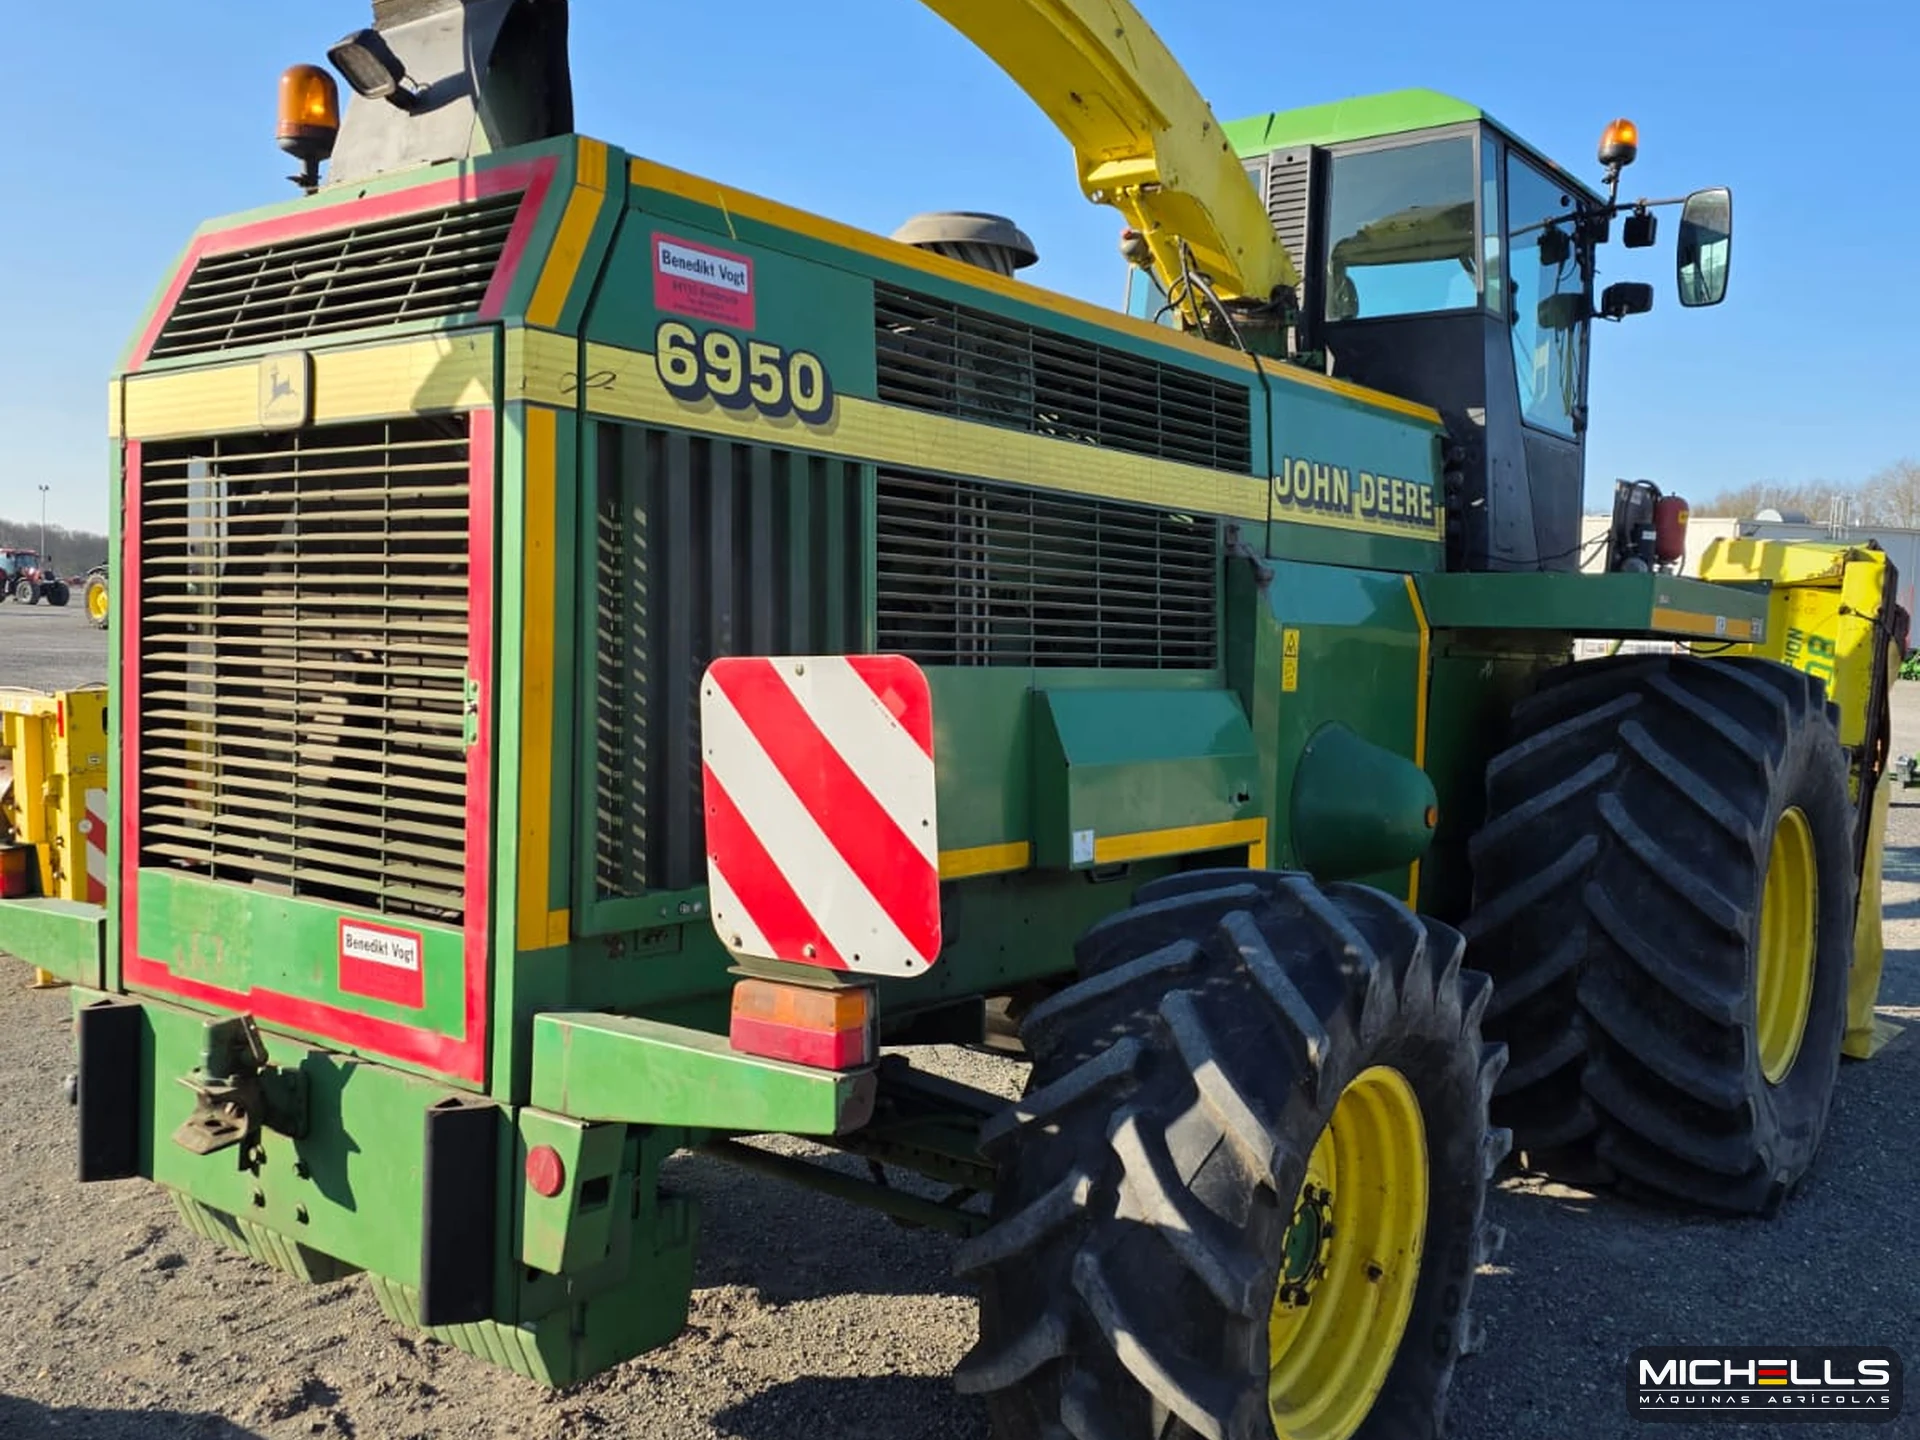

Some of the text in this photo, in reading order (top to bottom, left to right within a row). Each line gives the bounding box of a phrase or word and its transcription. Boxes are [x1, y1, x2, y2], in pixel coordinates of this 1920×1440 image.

[662, 249, 746, 287] Benedikt Vogt
[656, 319, 834, 425] 6950
[1274, 456, 1436, 527] JOHN DEERE
[346, 933, 414, 964] Benedikt Vogt
